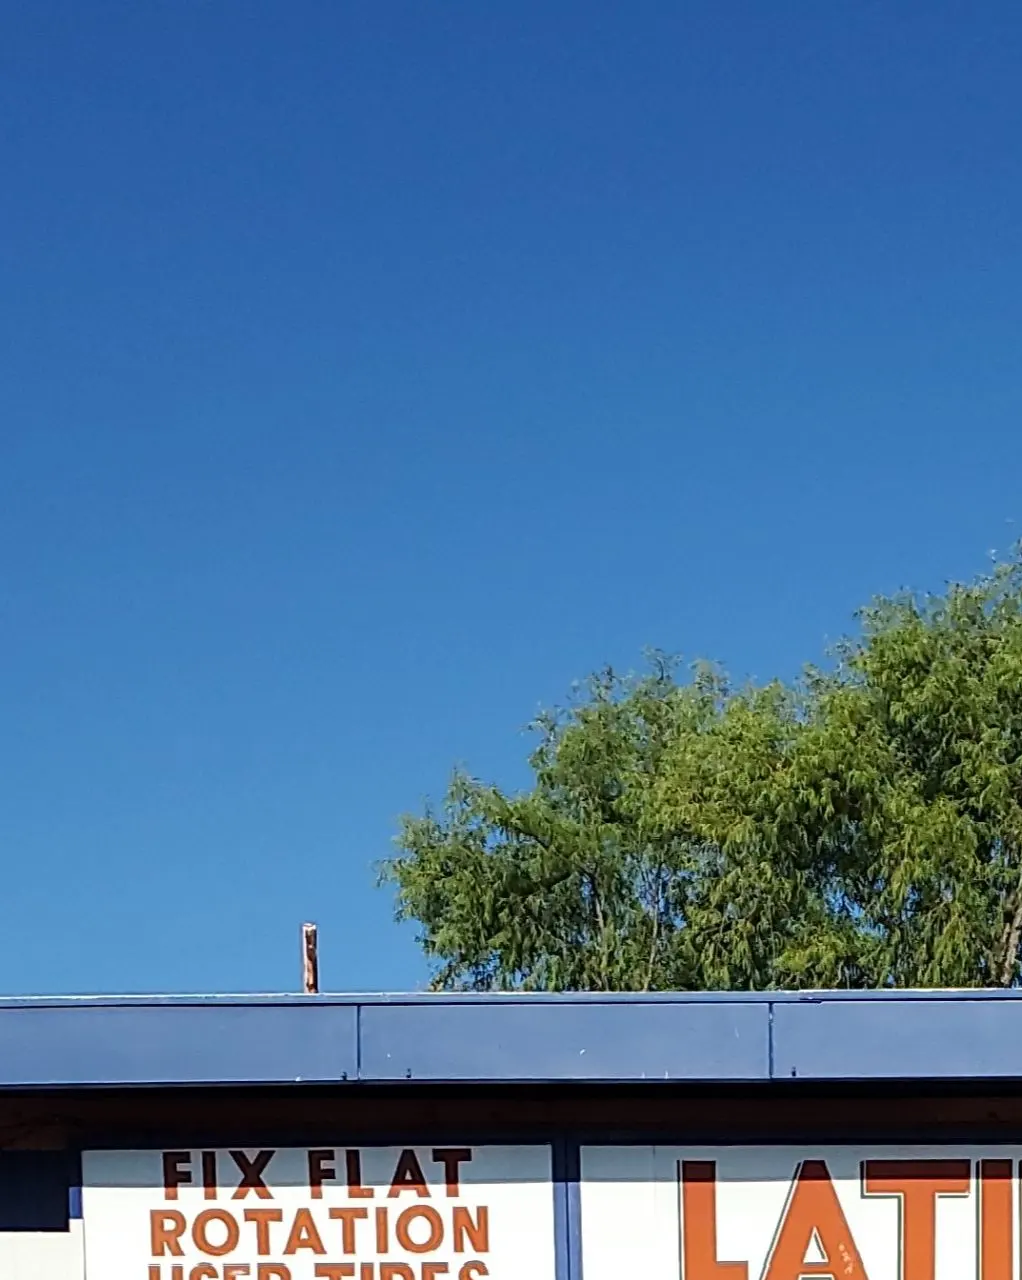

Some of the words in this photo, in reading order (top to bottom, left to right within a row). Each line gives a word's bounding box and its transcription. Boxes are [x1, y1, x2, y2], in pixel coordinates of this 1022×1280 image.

[162, 1149, 275, 1200] FIX
[308, 1147, 472, 1199] FLAT
[149, 1205, 489, 1257] ROTATION
